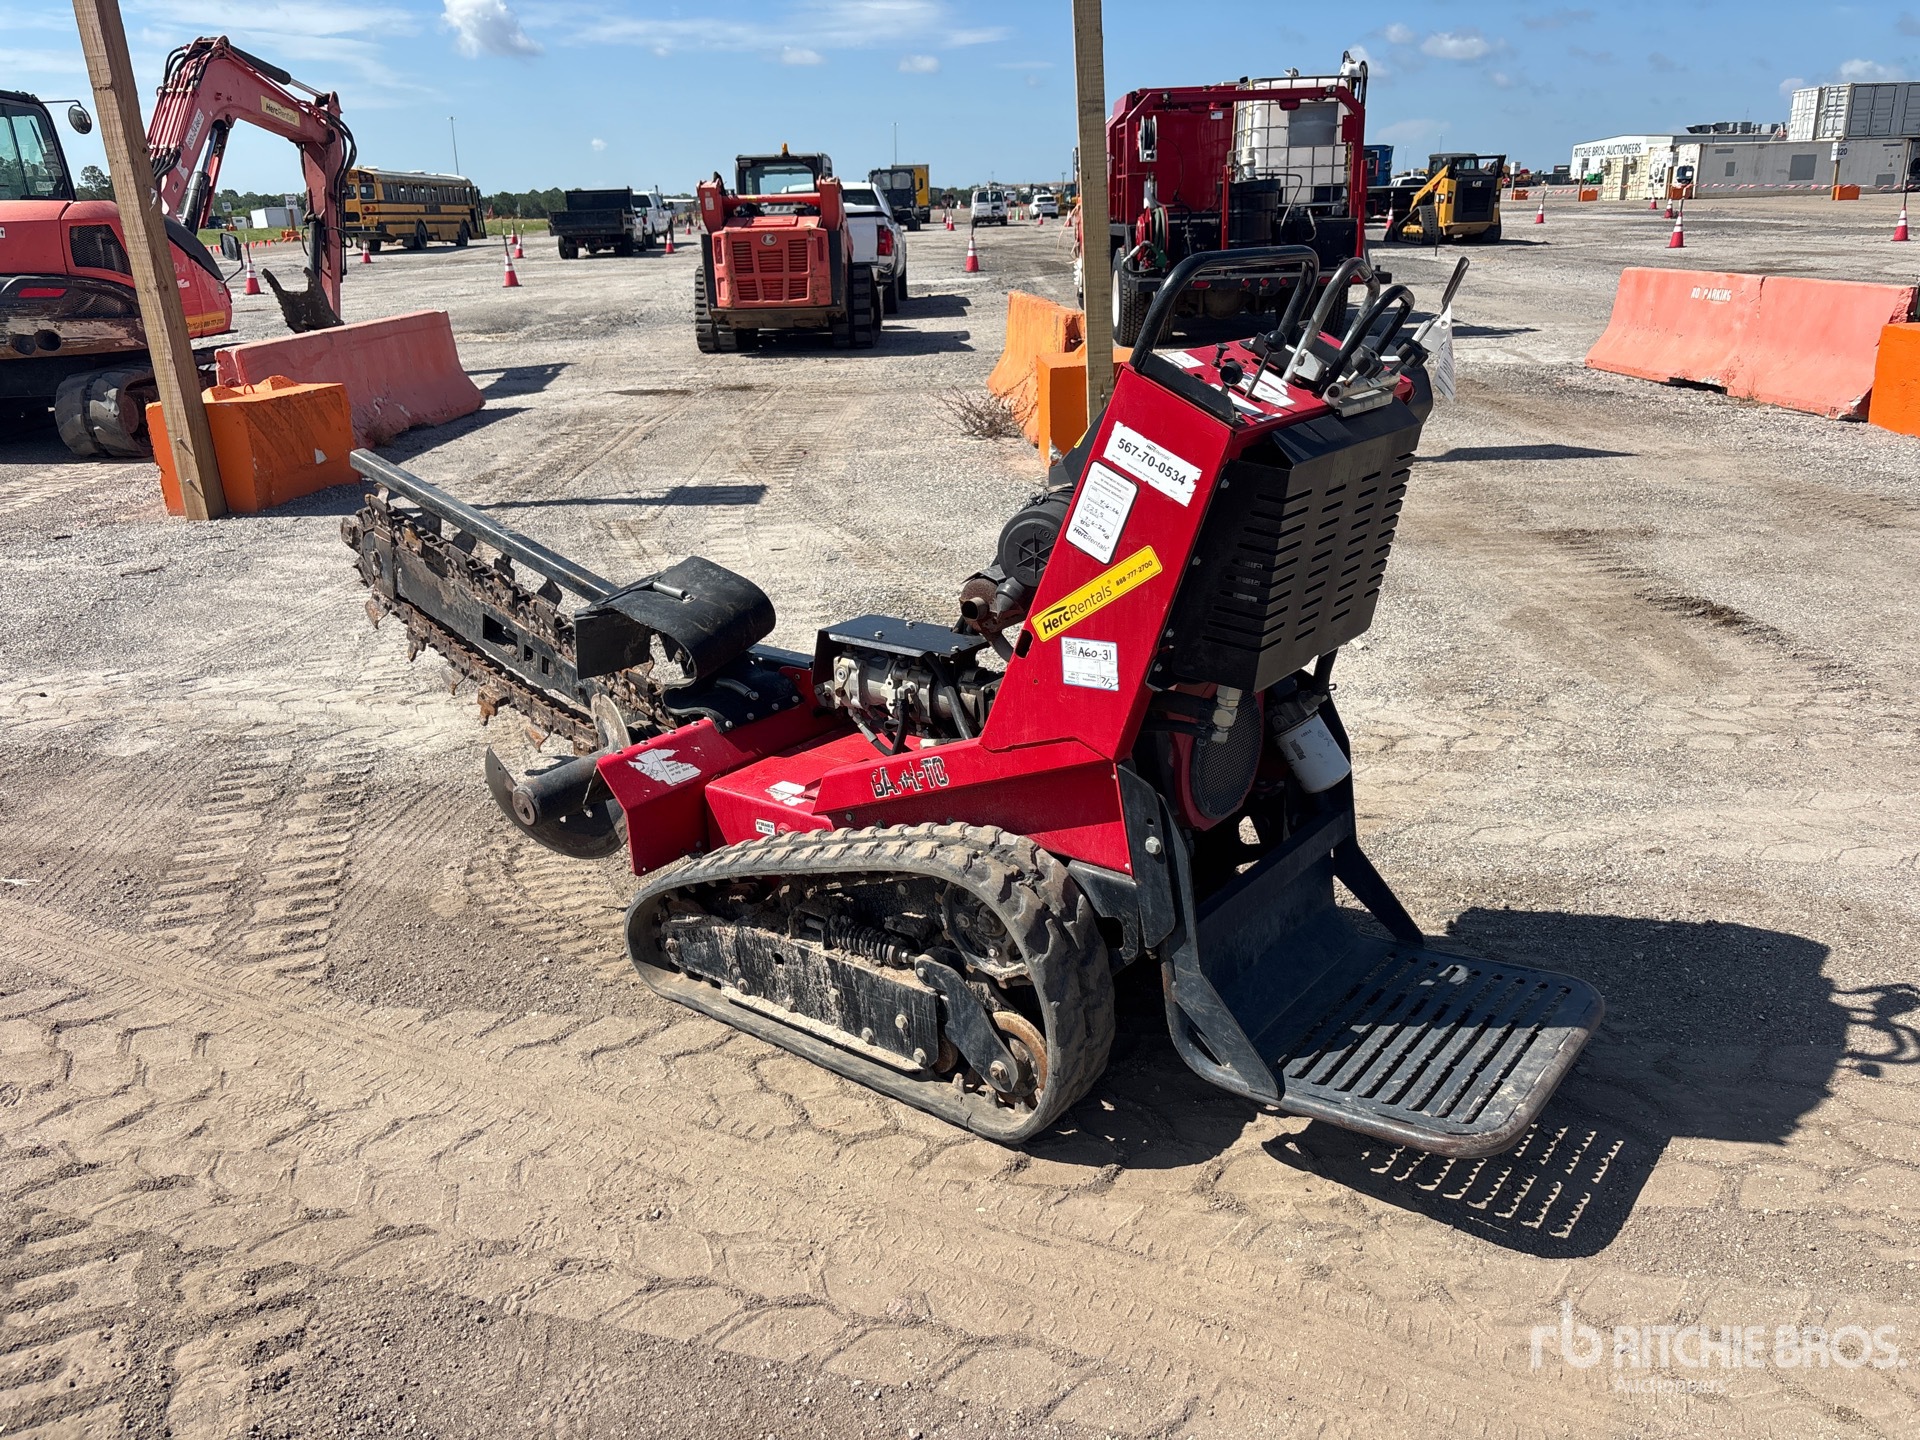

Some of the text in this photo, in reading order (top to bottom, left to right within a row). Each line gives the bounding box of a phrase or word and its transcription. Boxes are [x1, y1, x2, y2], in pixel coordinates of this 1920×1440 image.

[1574, 146, 1592, 158] RITCHIE
[1606, 142, 1642, 155] AUCTIONEERS
[1690, 287, 1732, 302] NO PARKING
[1117, 438, 1187, 486] 567-70-0534
[1073, 527, 1108, 552] HercRentals
[1041, 560, 1154, 634] HercRentals 888-777-2700
[1078, 646, 1112, 661] A60-31
